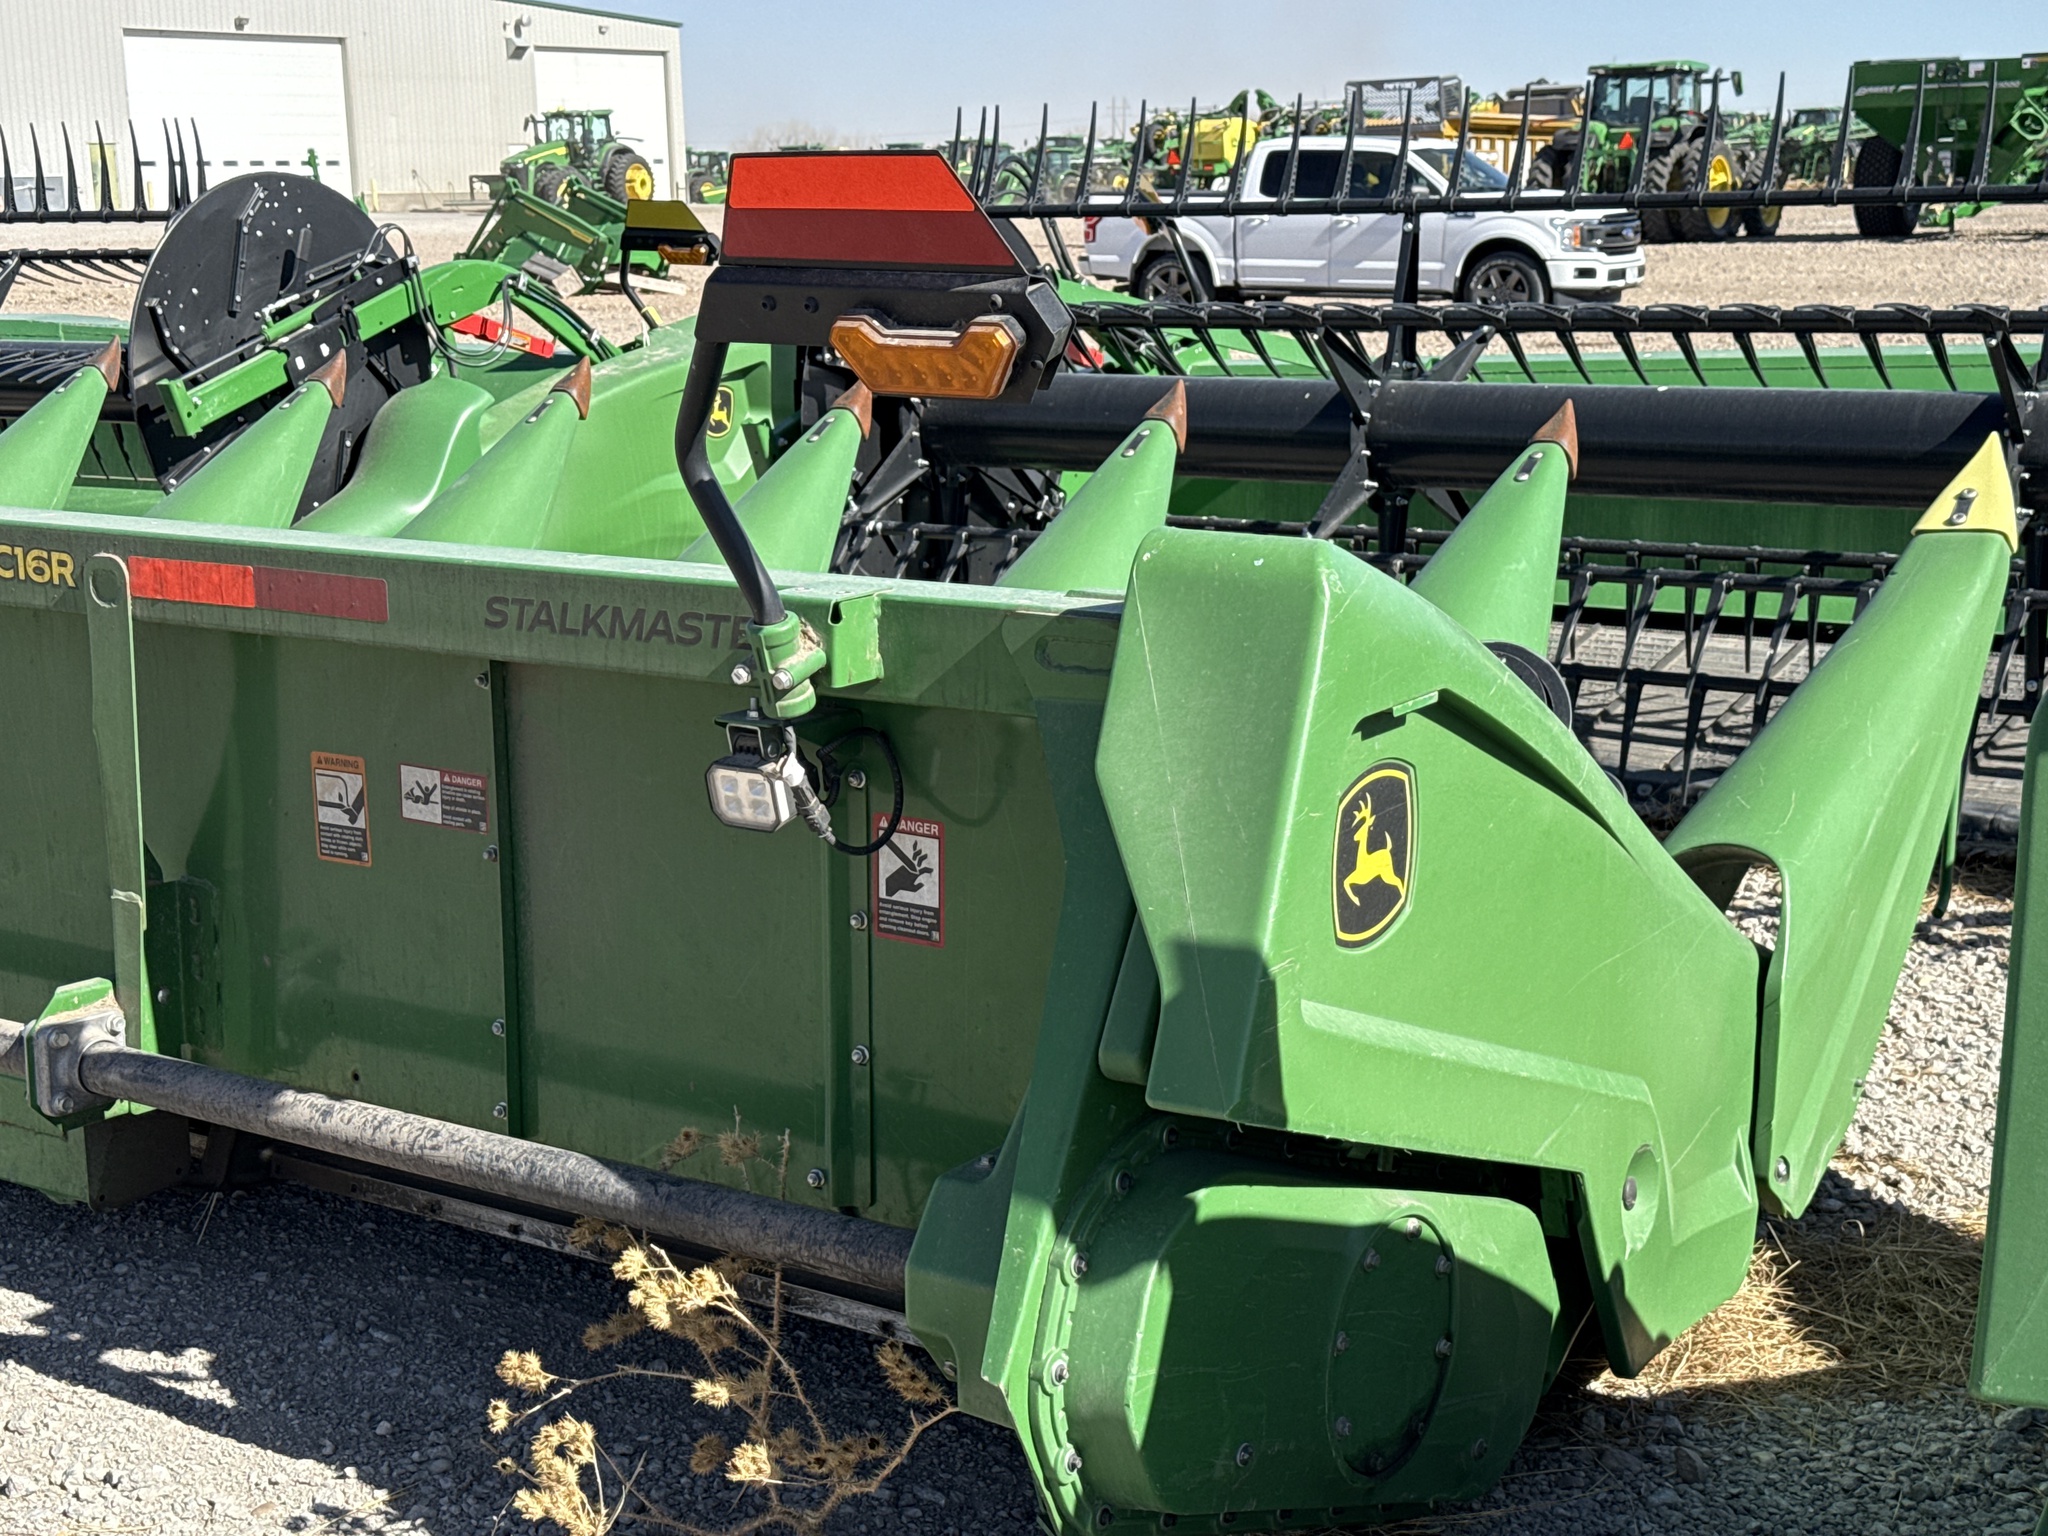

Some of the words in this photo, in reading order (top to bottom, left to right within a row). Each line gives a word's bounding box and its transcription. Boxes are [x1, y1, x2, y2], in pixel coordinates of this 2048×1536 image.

[0, 543, 77, 588] C16R
[484, 596, 753, 651] STALKMASTE
[324, 756, 359, 769] WARNING
[452, 775, 482, 787] DANGER
[896, 819, 939, 836] ANGER
